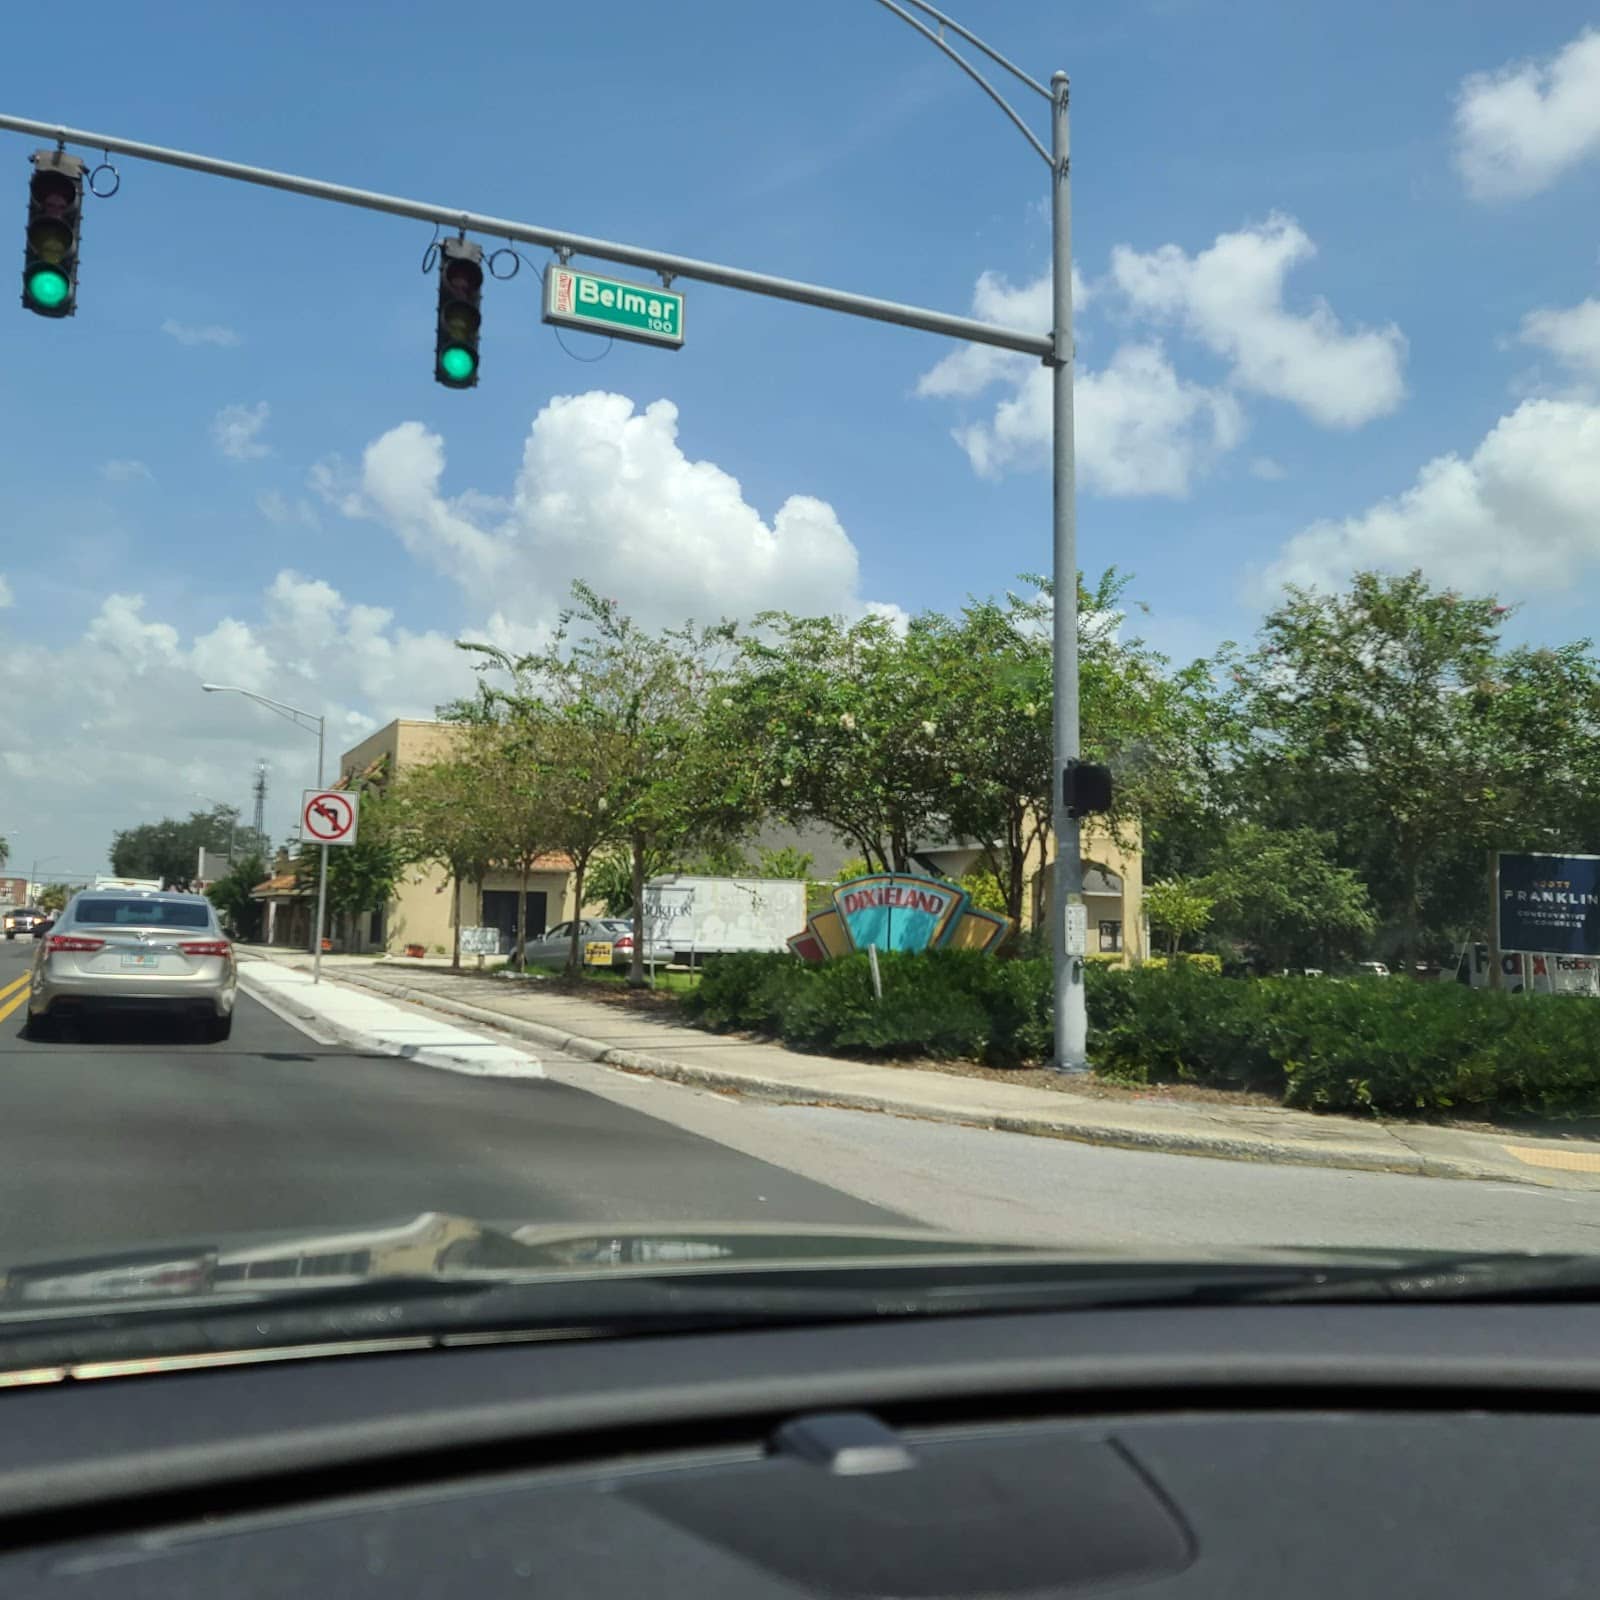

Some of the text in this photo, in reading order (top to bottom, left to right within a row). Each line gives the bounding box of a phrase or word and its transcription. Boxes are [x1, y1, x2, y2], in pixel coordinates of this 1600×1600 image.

[579, 278, 675, 320] Belmar
[648, 317, 673, 333] 100
[1503, 889, 1599, 905] FRANKLIN
